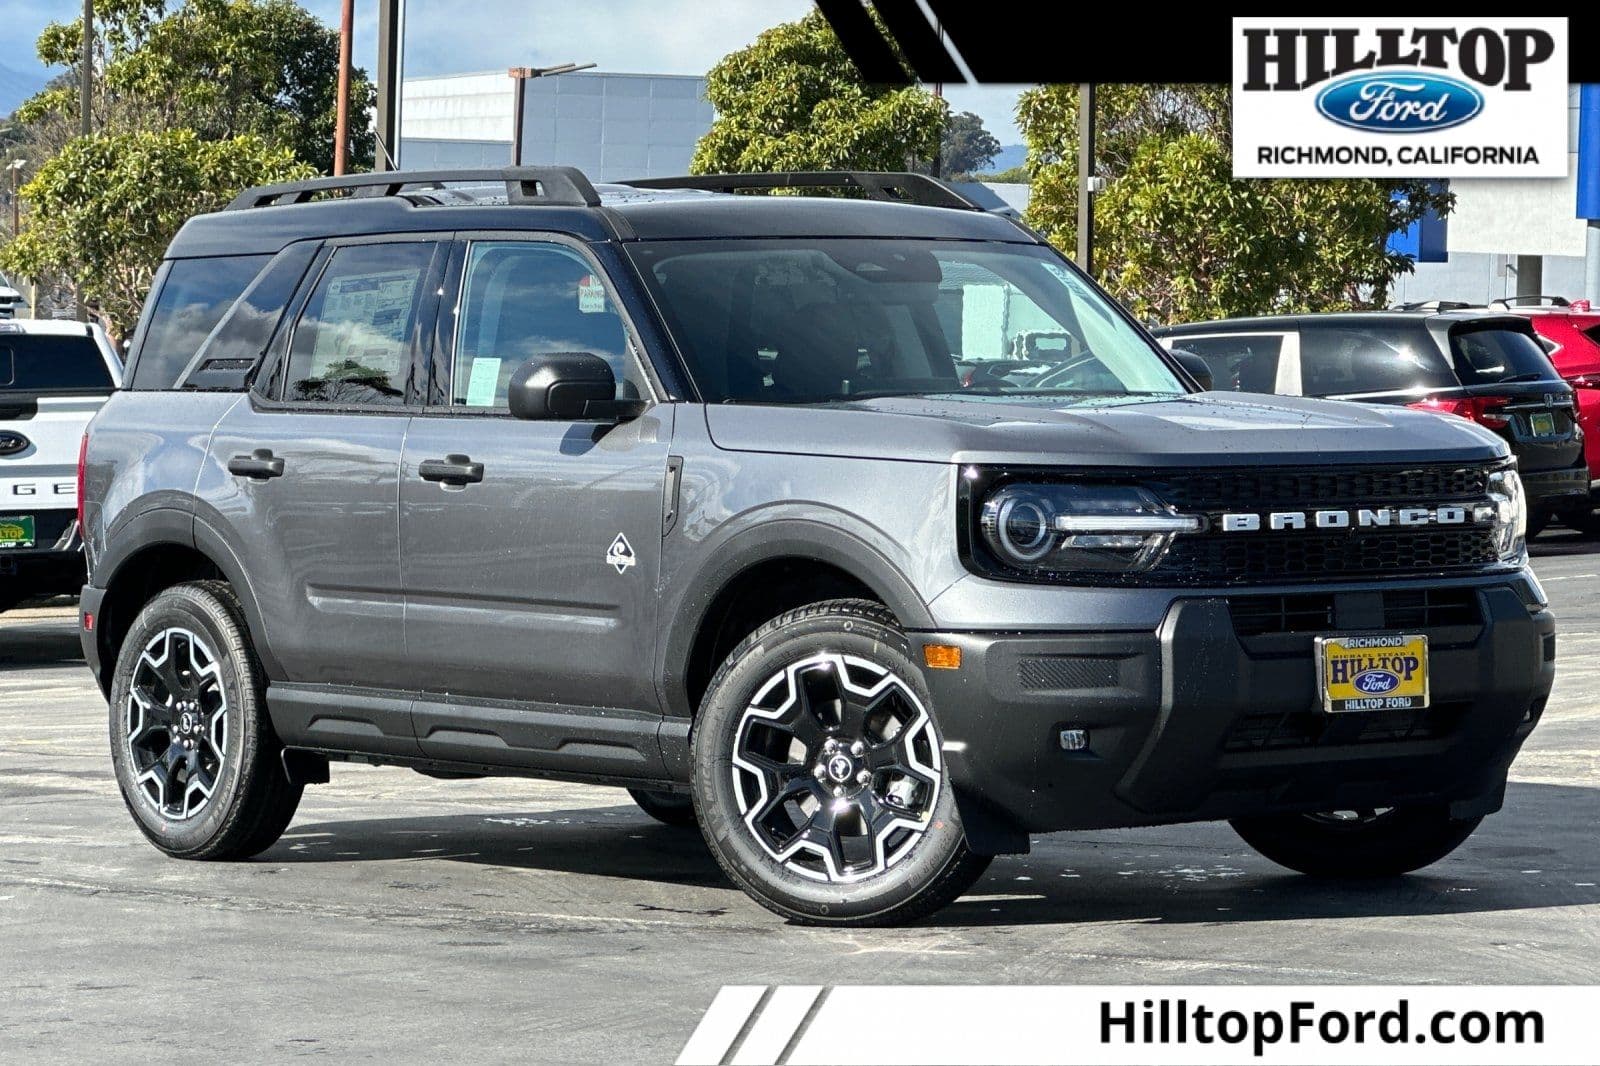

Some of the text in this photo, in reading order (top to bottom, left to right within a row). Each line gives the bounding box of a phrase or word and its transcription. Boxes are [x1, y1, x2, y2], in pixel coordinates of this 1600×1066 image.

[1222, 508, 1465, 531] BRONCO
[1348, 637, 1402, 648] RICHMOND
[1331, 656, 1419, 684] HILLTOP
[1362, 673, 1391, 691] Ford
[1345, 697, 1411, 710] HILLTOP FORD
